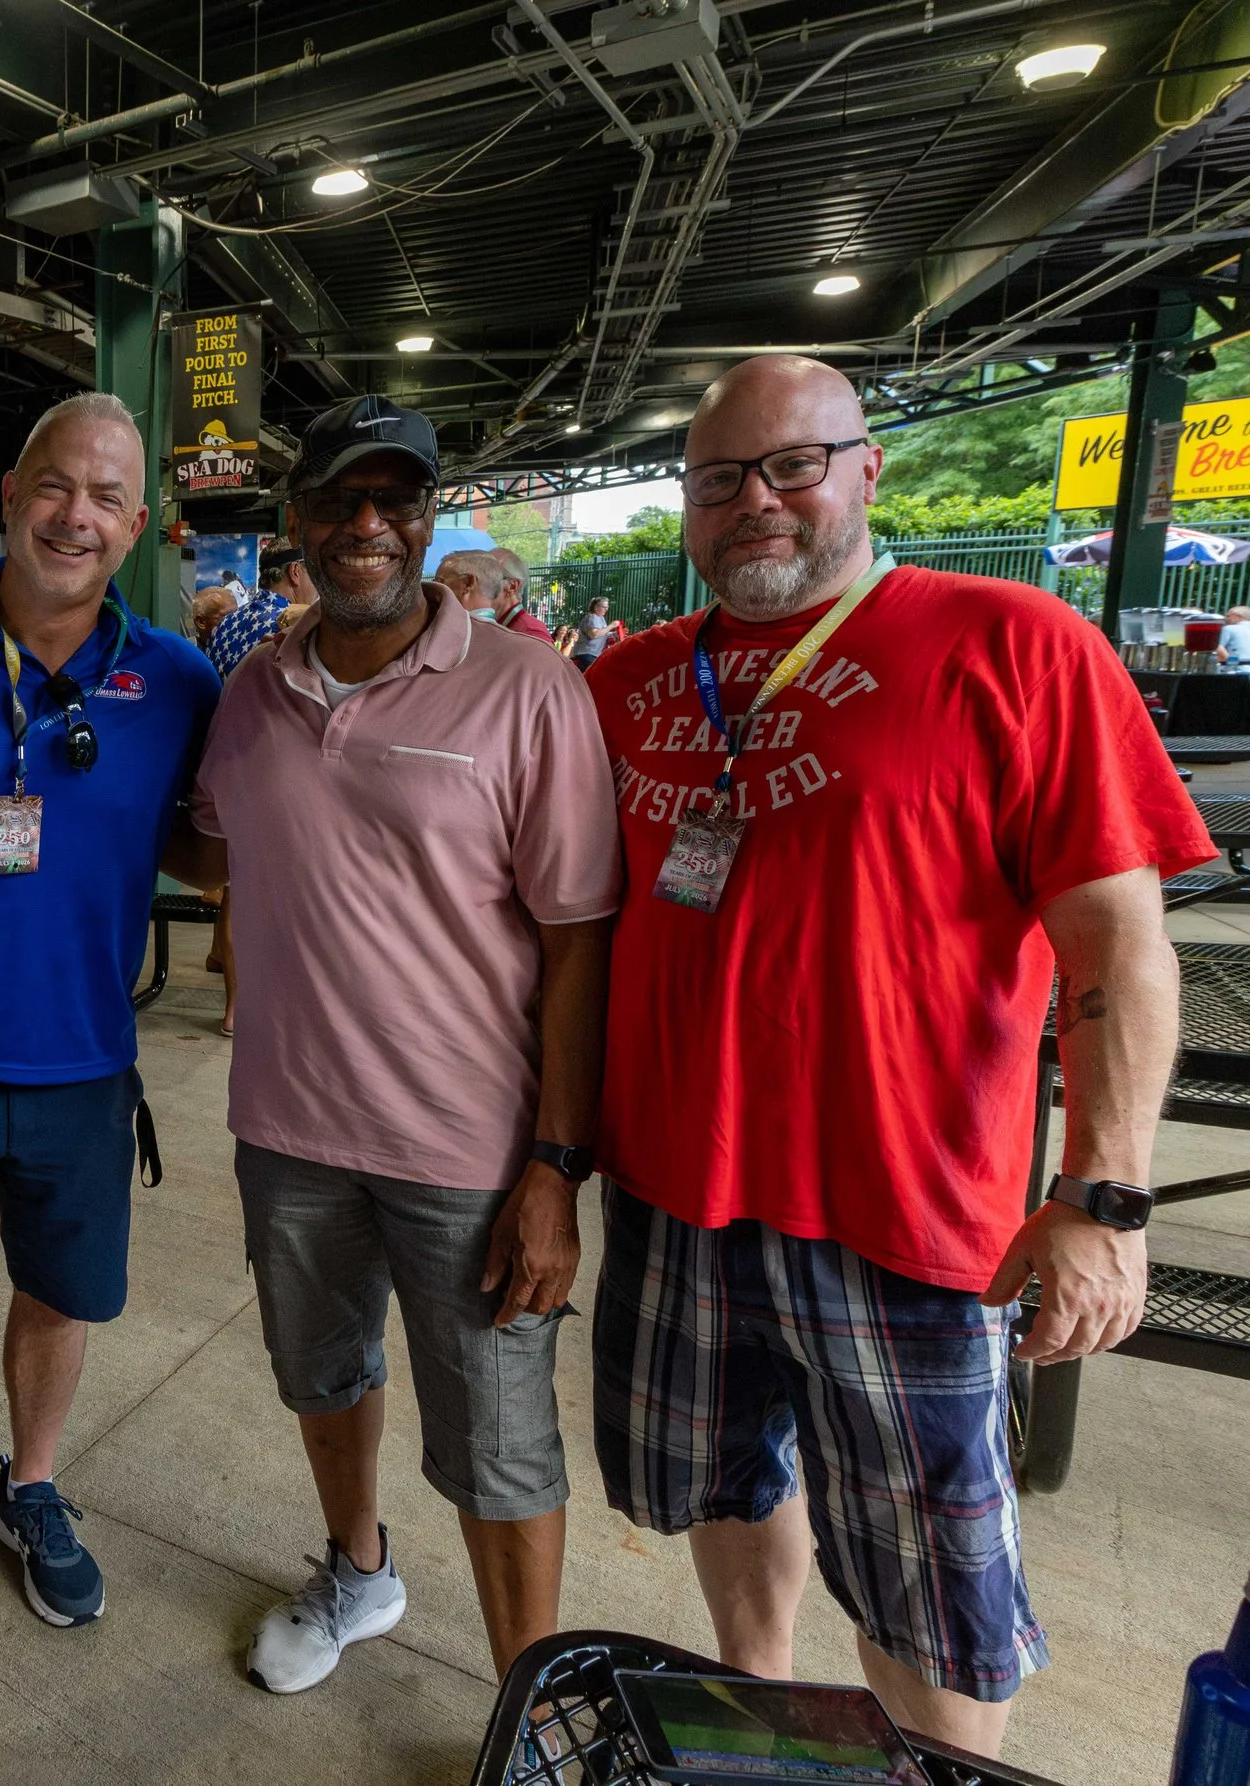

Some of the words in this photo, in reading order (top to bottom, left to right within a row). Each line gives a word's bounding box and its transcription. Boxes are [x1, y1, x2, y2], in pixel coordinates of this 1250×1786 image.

[196, 314, 237, 334] FROM
[196, 333, 237, 353] FIRST
[185, 355, 226, 373] POUR
[227, 351, 247, 368] TO
[193, 371, 236, 390] FINAL
[192, 391, 238, 409] PITCH.
[177, 461, 212, 482] SEA
[216, 457, 255, 477] DOG
[189, 473, 242, 491] BREWPEN
[797, 635, 822, 659] 200
[626, 648, 879, 721] STUVESANT
[698, 669, 714, 687] 200
[751, 658, 798, 713] BICENTENNIAL
[39, 711, 67, 731] LOWELL
[640, 711, 802, 752] LEADER
[612, 755, 756, 825] PHYSICL
[766, 752, 842, 810] ED.
[675, 851, 717, 875] 250
[664, 884, 681, 894] JULY
[691, 892, 708, 901] 2026
